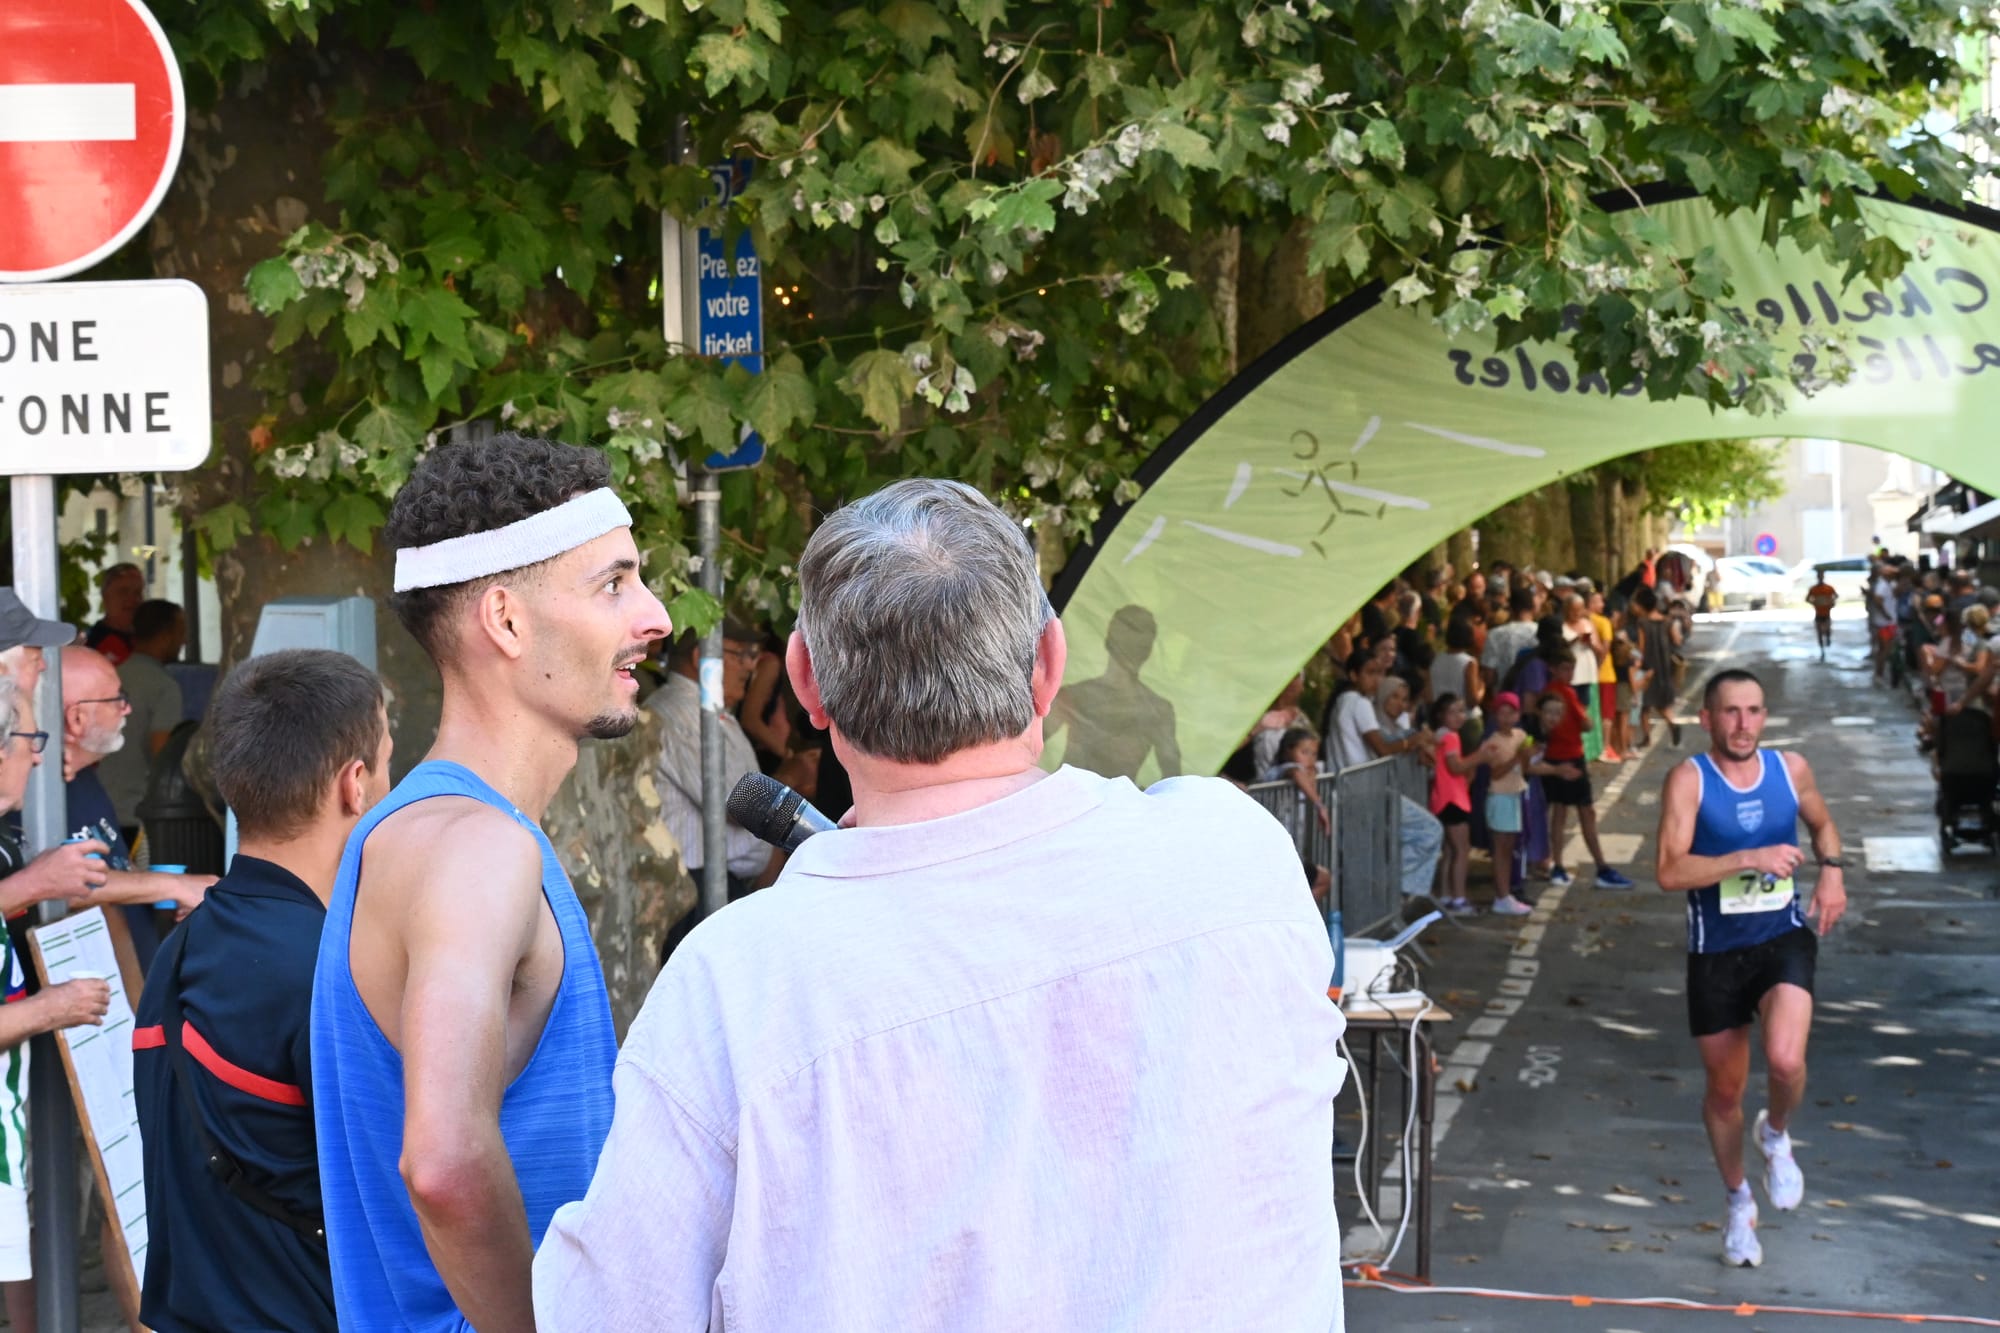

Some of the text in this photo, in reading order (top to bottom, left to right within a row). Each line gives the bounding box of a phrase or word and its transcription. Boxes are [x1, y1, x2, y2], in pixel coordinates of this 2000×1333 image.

[701, 254, 757, 279] Preez
[707, 291, 750, 318] votre
[0, 320, 99, 363] ONE
[705, 331, 753, 358] ticket
